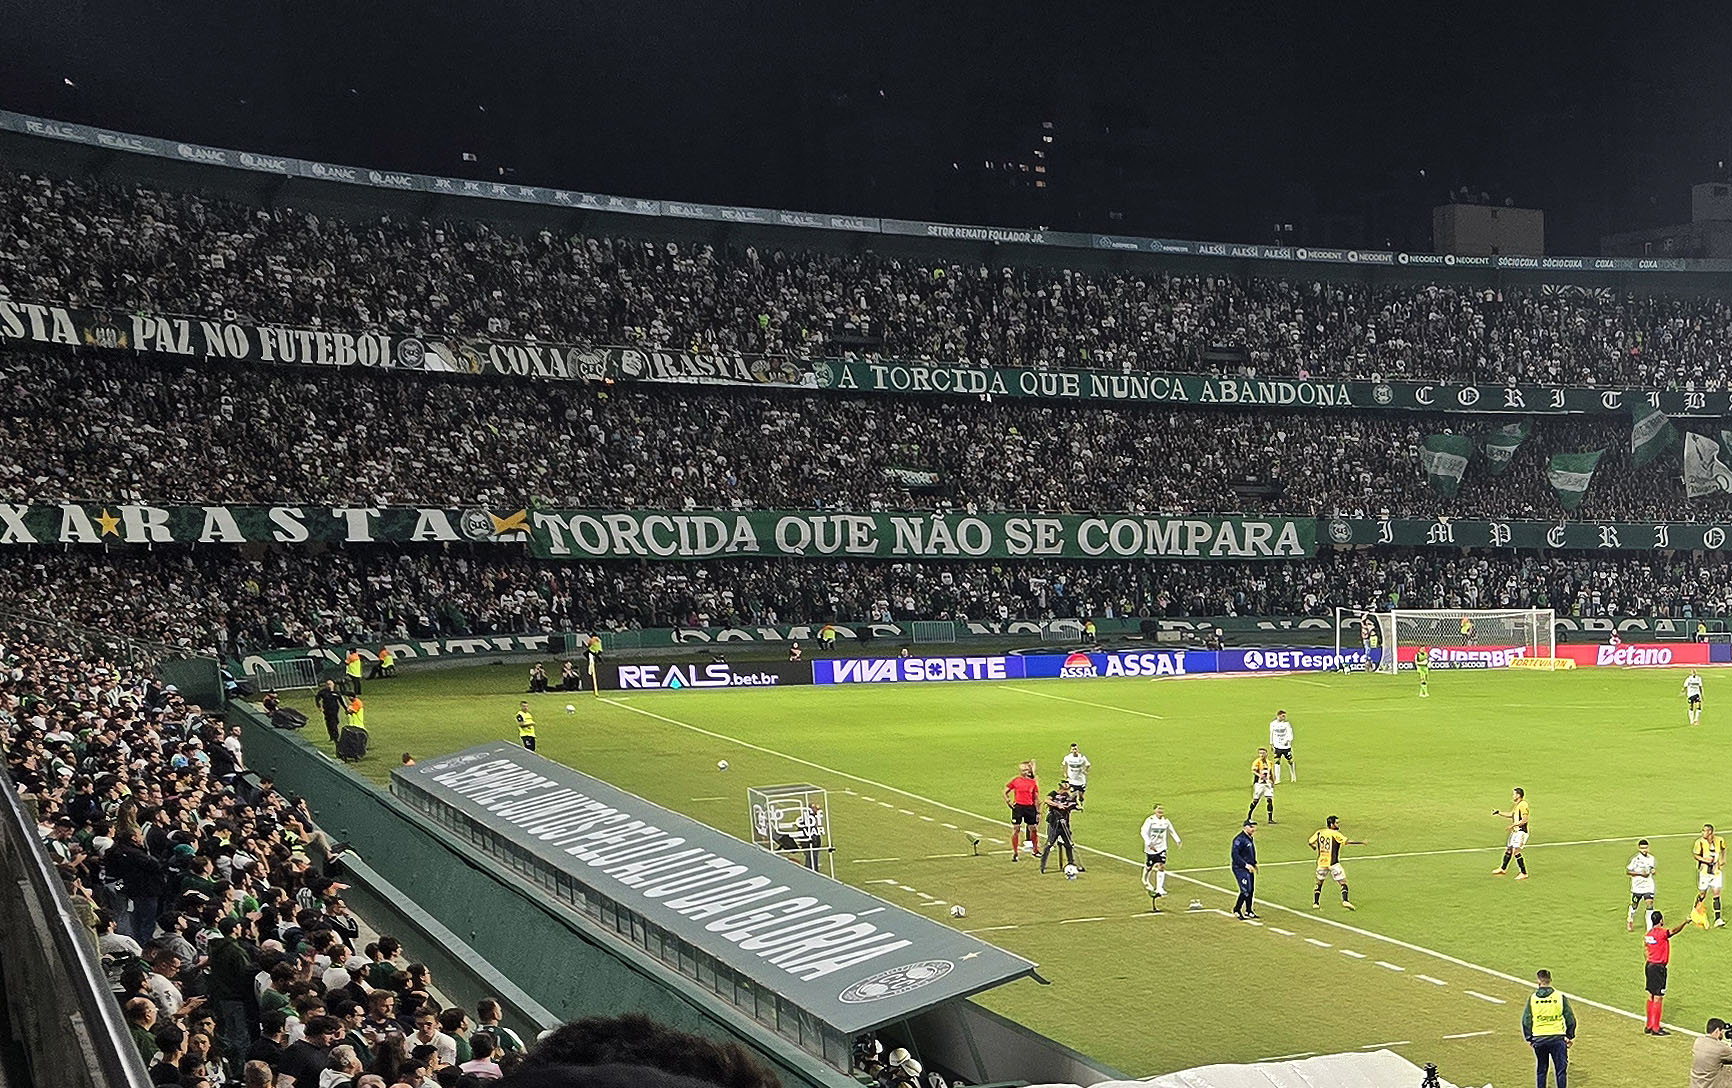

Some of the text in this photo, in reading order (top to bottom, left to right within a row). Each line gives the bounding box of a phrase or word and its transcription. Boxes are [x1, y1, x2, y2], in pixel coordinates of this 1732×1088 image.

[928, 225, 1044, 244] SETOR RENATO FOLLADOR JR.
[1308, 250, 1342, 260] NEODENT
[1359, 253, 1392, 263] NEODENT
[1410, 255, 1443, 264] NEODENT
[1456, 256, 1489, 265] NEODENT
[129, 313, 195, 361] PAZ
[200, 319, 250, 362] NO
[257, 325, 398, 373] FUTEBOL
[488, 343, 569, 378] COXA
[647, 350, 754, 382] RASTA
[838, 363, 1352, 407] A TORCIDA QUE NUNCA ABANDONA
[117, 503, 460, 543] RASTA
[533, 511, 1305, 558] TORCIDA QUE NÃO SE COMPARA
[1428, 646, 1527, 669] SUPERBET
[1597, 644, 1672, 665] Betano
[832, 656, 1007, 683] VIVA SORTE
[433, 759, 912, 983] SEMPRE JUNTOS PELO ALTO DA GLÓRIA
